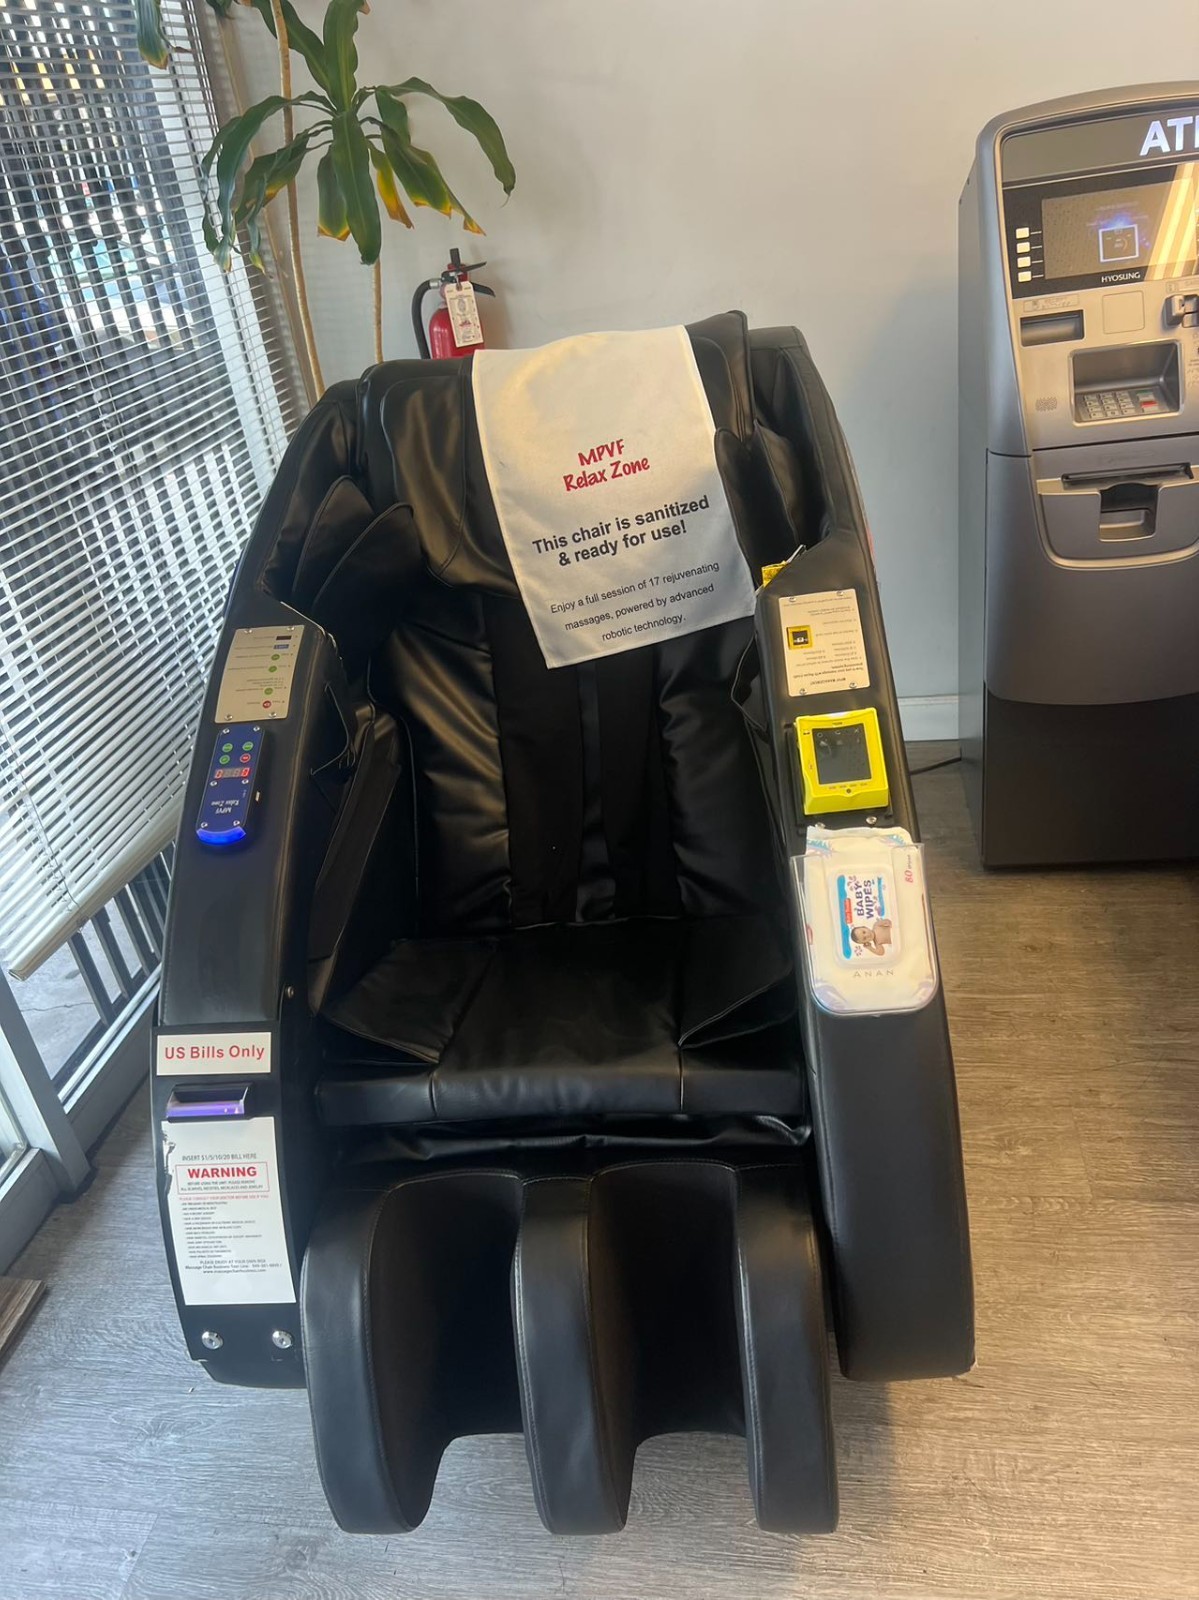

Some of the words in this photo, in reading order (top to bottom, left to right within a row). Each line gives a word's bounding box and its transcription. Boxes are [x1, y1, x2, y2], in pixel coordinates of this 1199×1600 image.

[1139, 115, 1199, 157] AT
[1101, 271, 1141, 284] HYOSUNG
[578, 439, 626, 466] MPVF
[563, 472, 608, 492] Relax
[611, 457, 651, 479] Zone
[532, 535, 568, 555] This
[572, 523, 611, 544] chair
[616, 516, 631, 531] is
[634, 495, 710, 525] sanitized
[558, 552, 571, 567] &
[574, 541, 619, 565] ready
[622, 532, 646, 548] for
[651, 520, 687, 542] use!
[550, 599, 576, 615] Enjoy
[578, 598, 585, 606] a
[585, 593, 600, 605] full
[601, 584, 636, 602] session
[638, 580, 648, 591] of
[649, 576, 660, 587] 17
[662, 562, 720, 585] rejuvenating
[565, 612, 615, 631] massages,
[615, 599, 656, 619] powered
[656, 595, 668, 608] by
[669, 584, 715, 603] advanced
[602, 625, 633, 641] robotic
[634, 613, 687, 635] technology.
[854, 883, 865, 917] BABY
[863, 880, 874, 919] WIPES
[852, 969, 894, 979] ANAN
[165, 1047, 186, 1060] US
[190, 1046, 225, 1059] Bills
[229, 1045, 265, 1060] Only
[187, 1166, 257, 1179] WARNING
